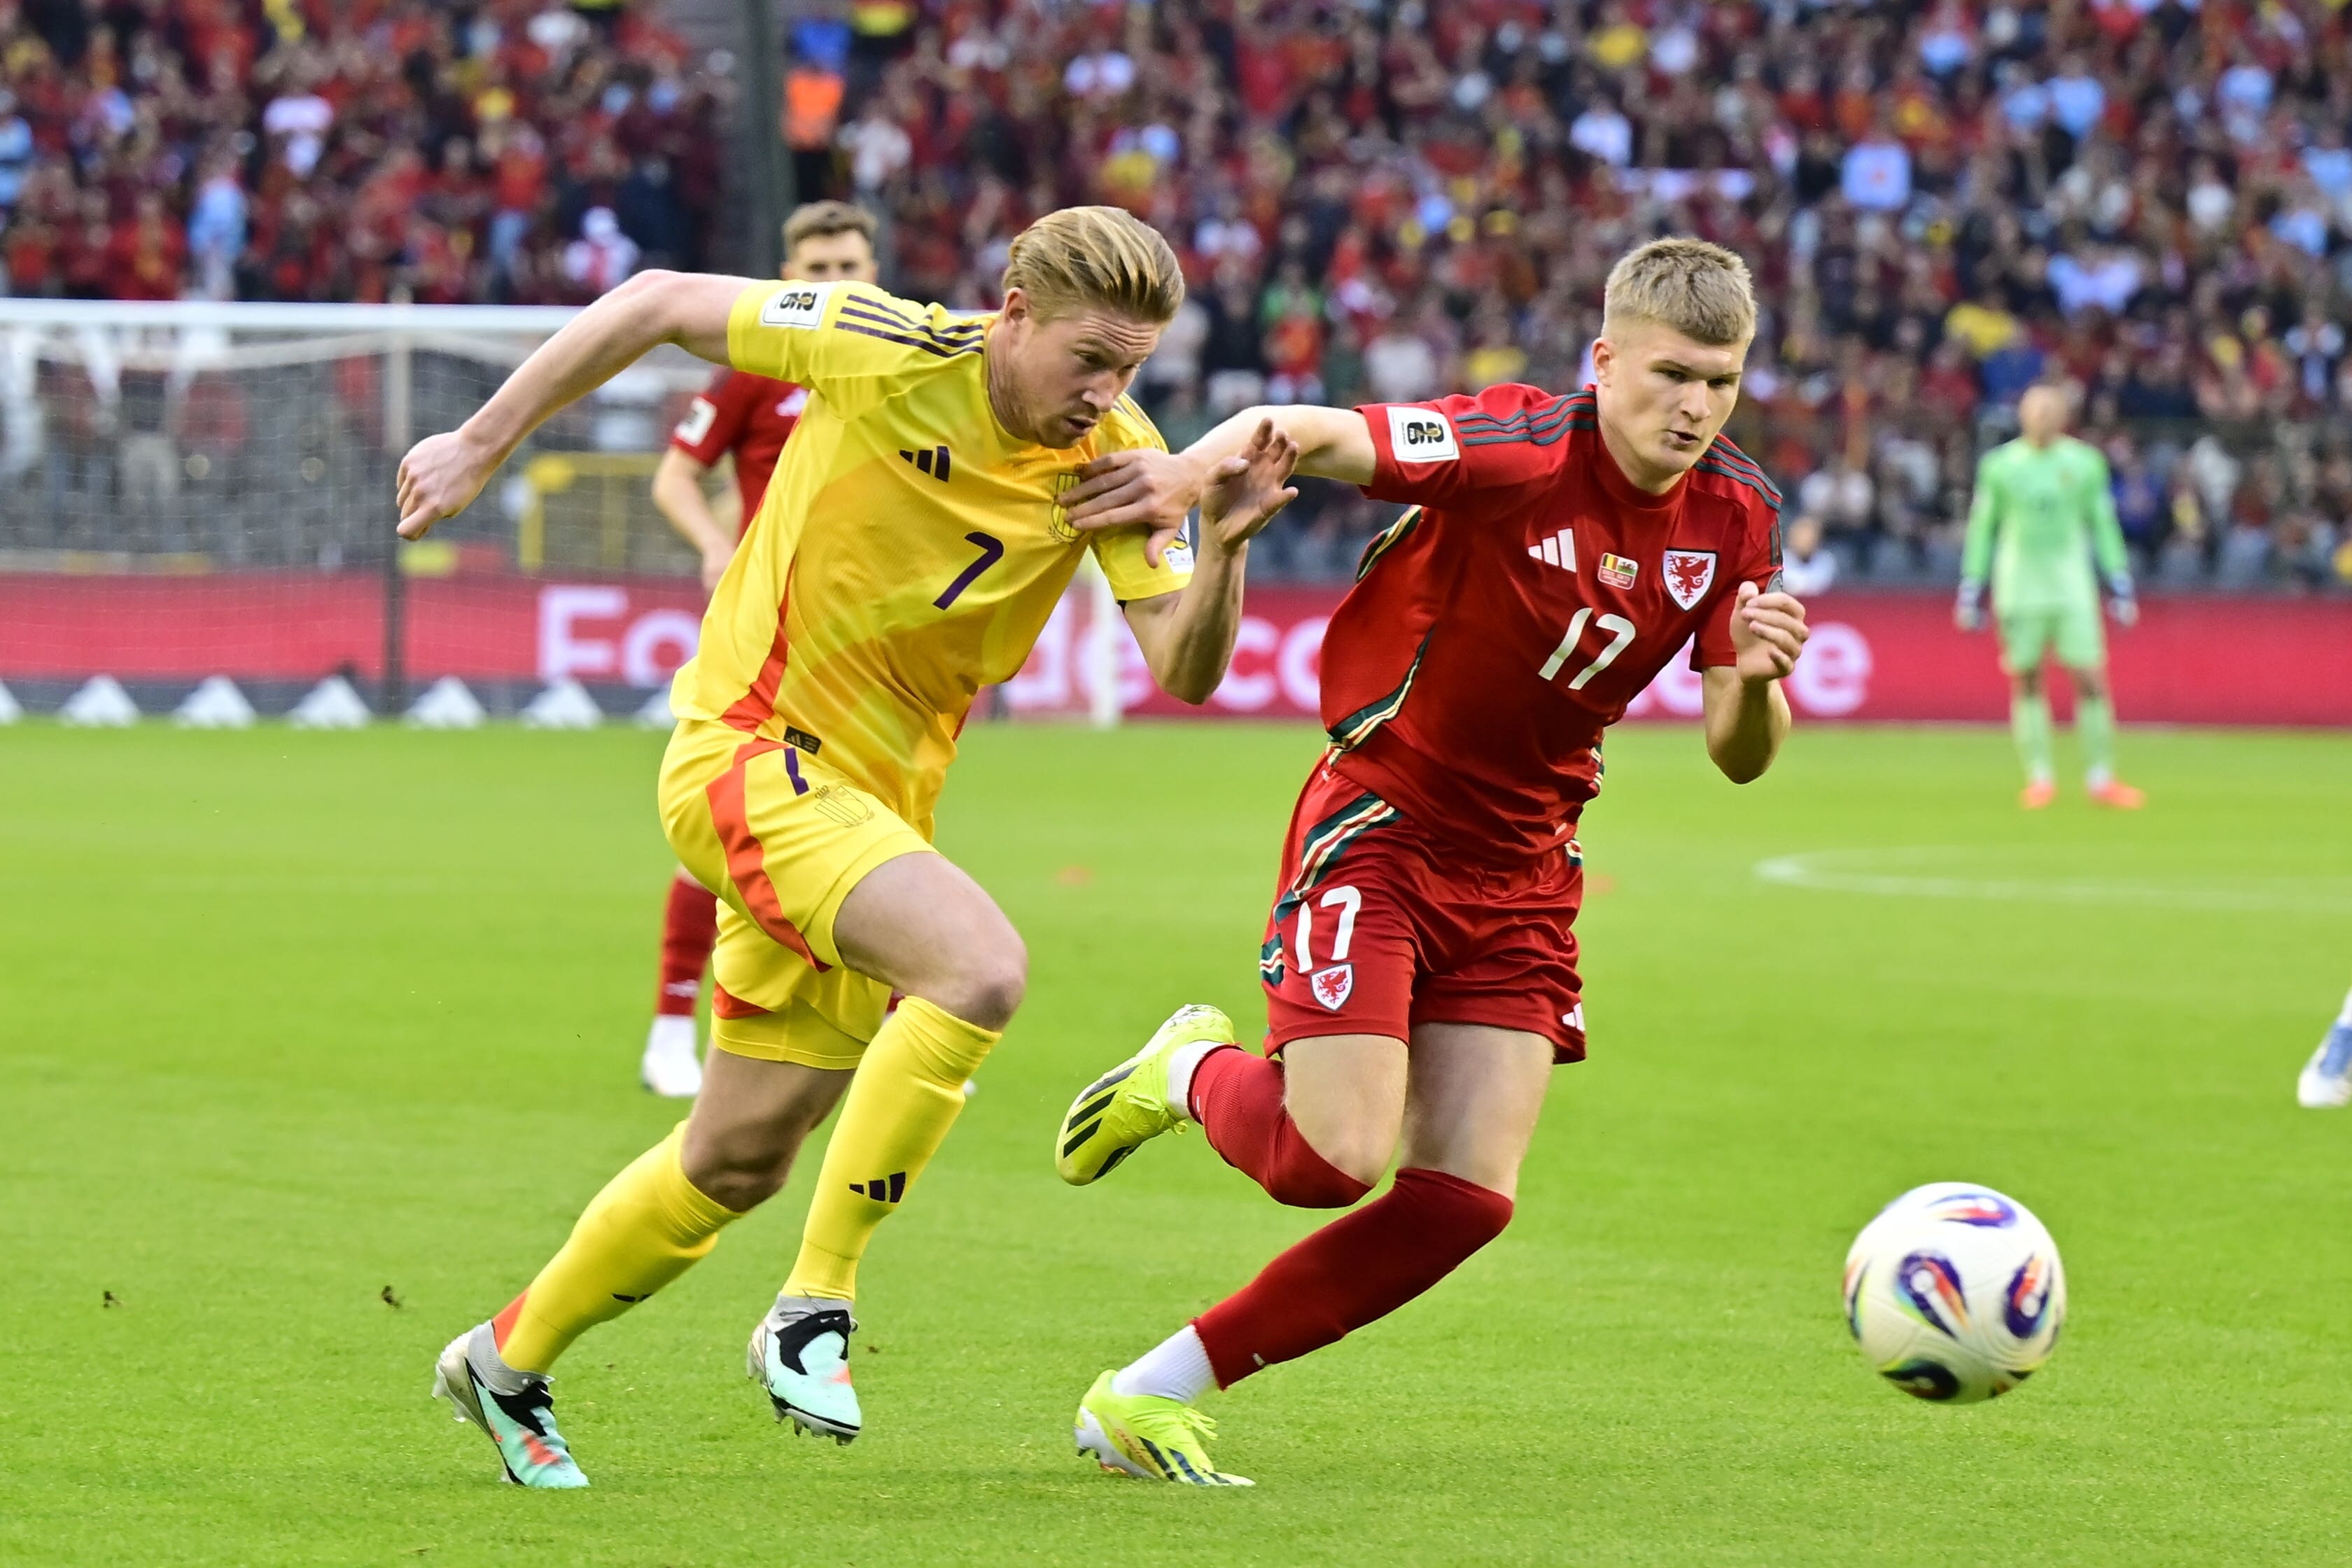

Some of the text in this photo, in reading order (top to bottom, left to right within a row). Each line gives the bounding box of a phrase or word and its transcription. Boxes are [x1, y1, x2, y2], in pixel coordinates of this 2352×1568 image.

[933, 531, 1004, 610] 7
[1537, 607, 1637, 691] 17
[1295, 885, 1362, 973] 17
